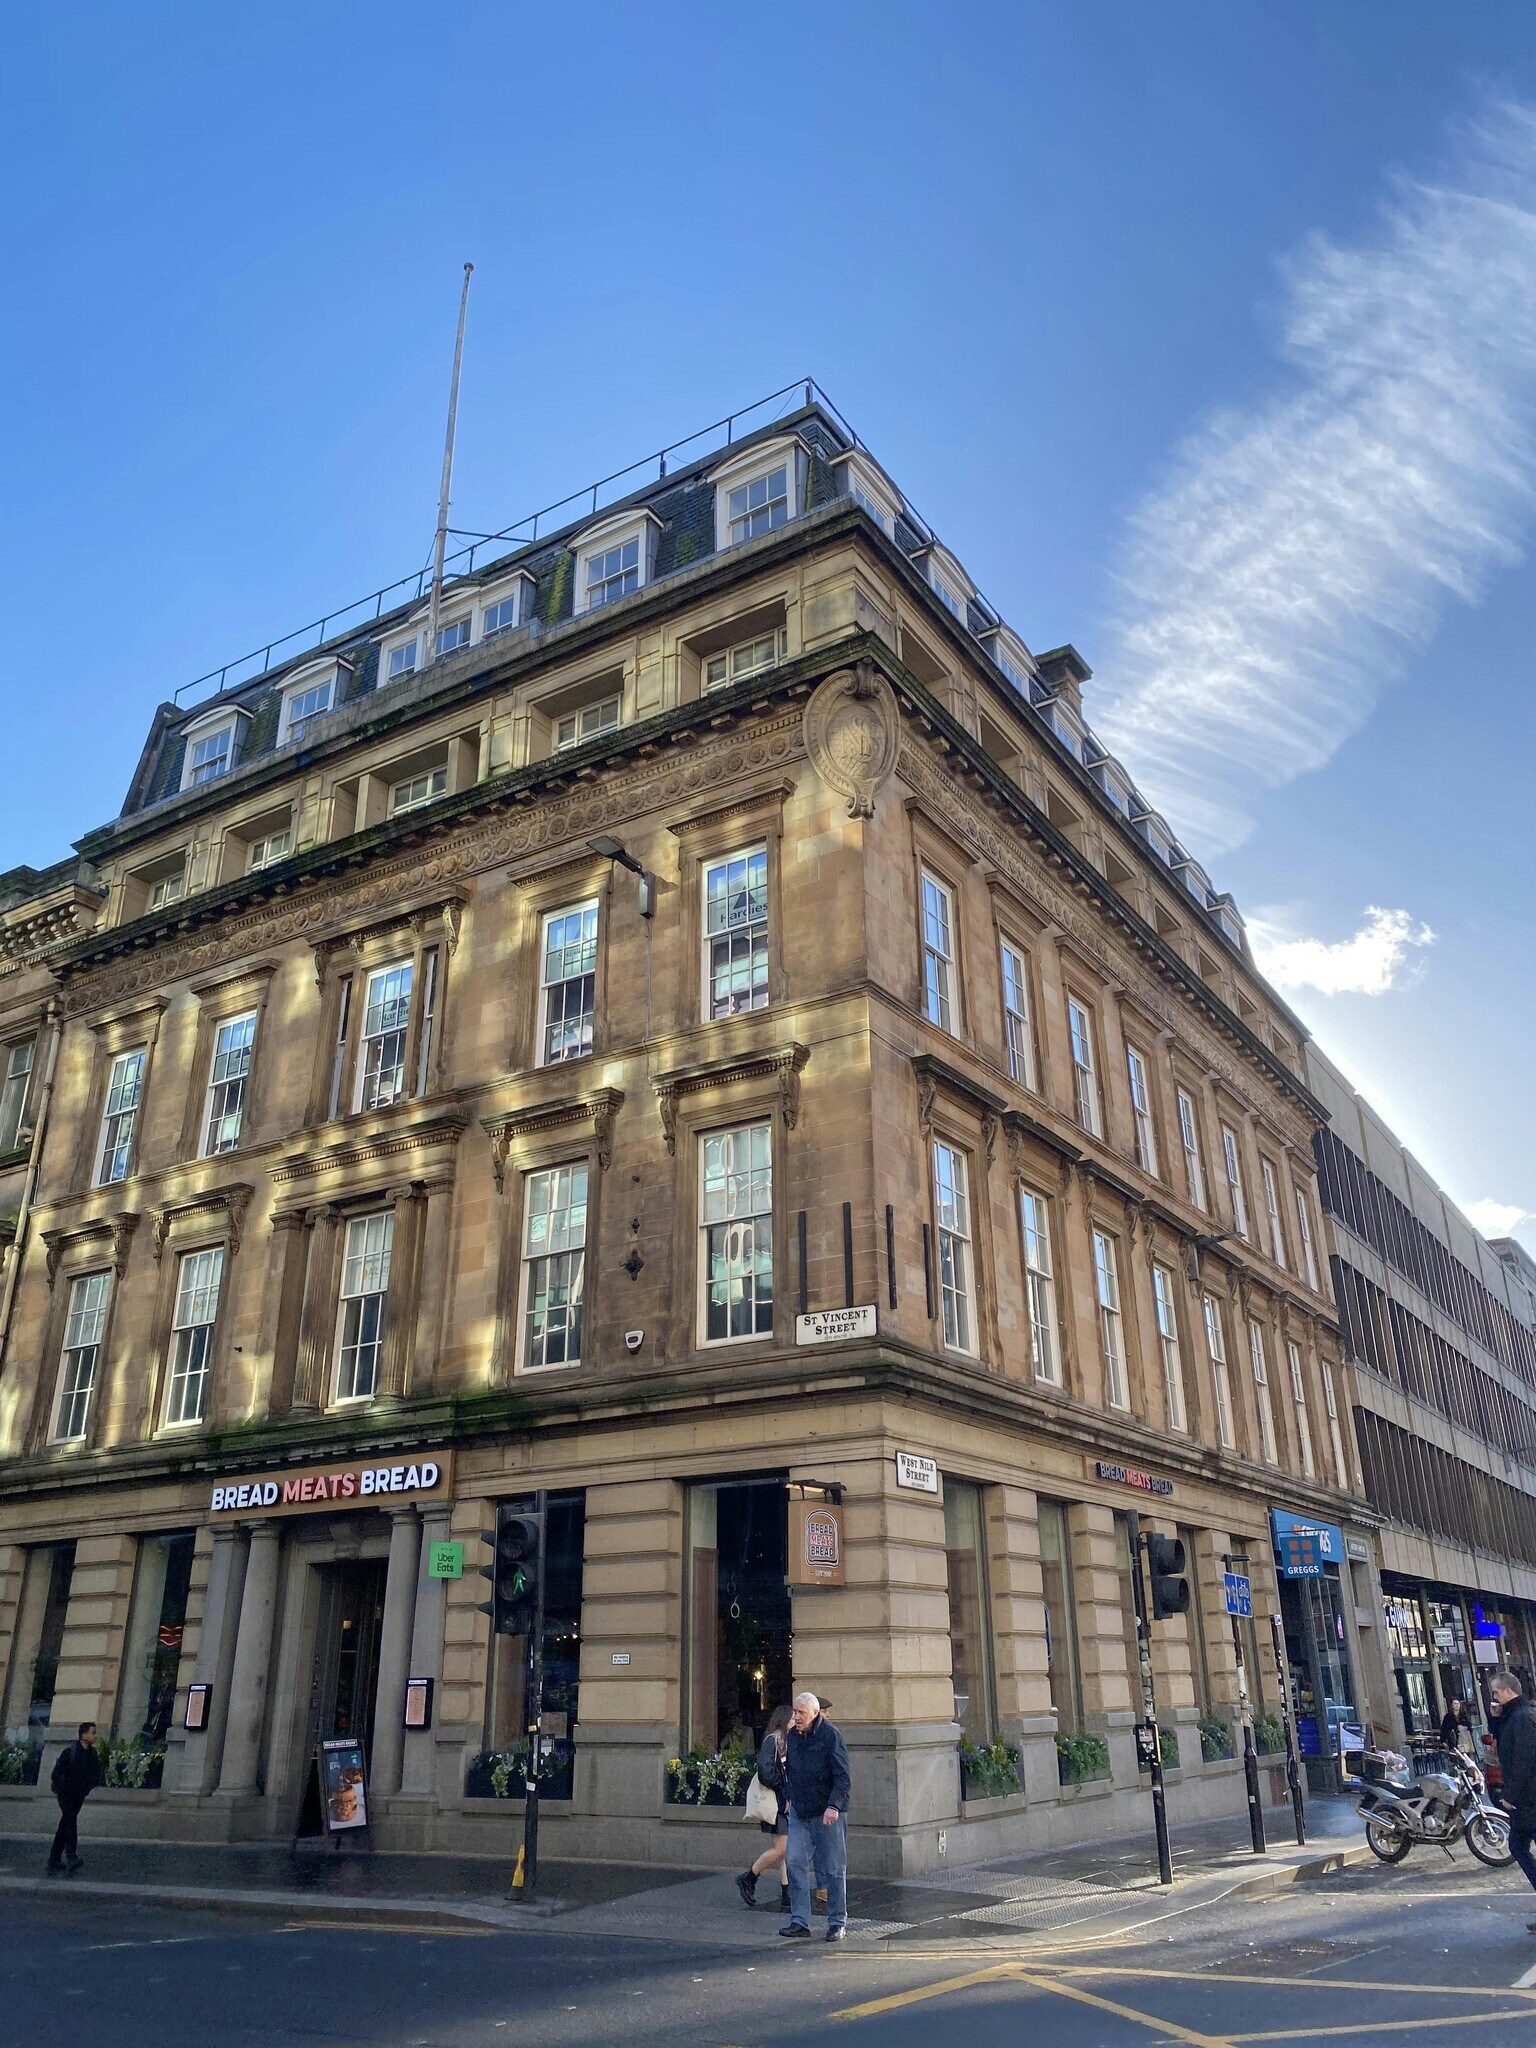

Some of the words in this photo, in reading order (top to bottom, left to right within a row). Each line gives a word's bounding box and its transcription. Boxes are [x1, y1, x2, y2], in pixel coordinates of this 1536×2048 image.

[1100, 1463, 1126, 1483] BREAD
[1126, 1469, 1151, 1490] MEATS
[1151, 1476, 1173, 1495] BREAD
[211, 1481, 278, 1511] BREAD
[282, 1472, 356, 1503] MEATS
[360, 1462, 438, 1495] BREAD
[810, 1523, 833, 1534] BREAD
[810, 1535, 833, 1546] MEATS
[810, 1546, 834, 1557] BREAD
[437, 1553, 455, 1562] Uber
[437, 1563, 454, 1572] Eats
[1287, 1565, 1319, 1575] GREGGS
